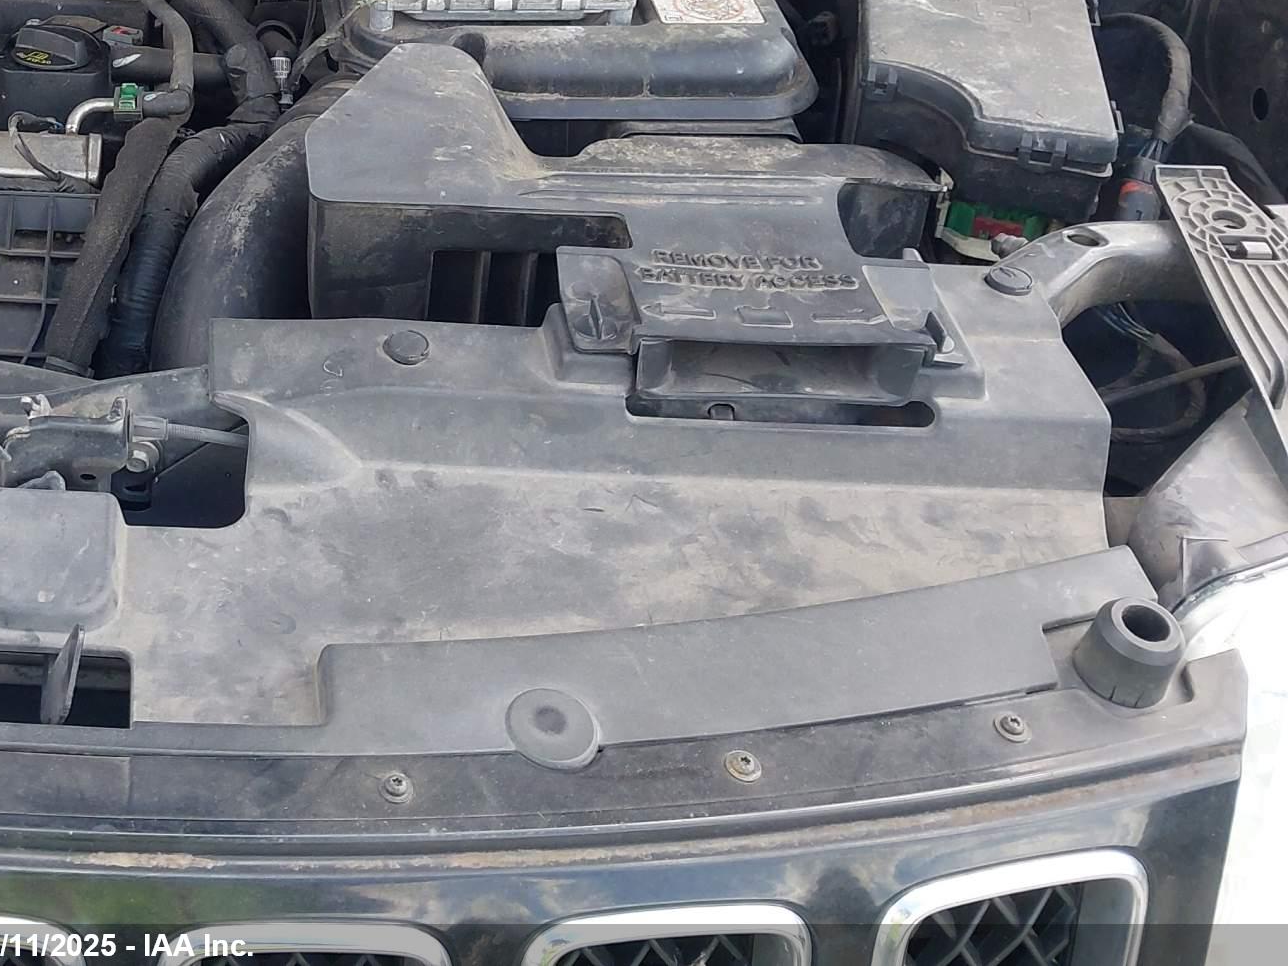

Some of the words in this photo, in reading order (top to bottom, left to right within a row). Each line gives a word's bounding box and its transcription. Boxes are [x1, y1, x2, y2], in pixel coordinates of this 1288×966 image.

[652, 250, 762, 271] REMOVE
[765, 255, 823, 271] FOR
[637, 266, 745, 290] BATTERY
[755, 274, 859, 291] ACCESS
